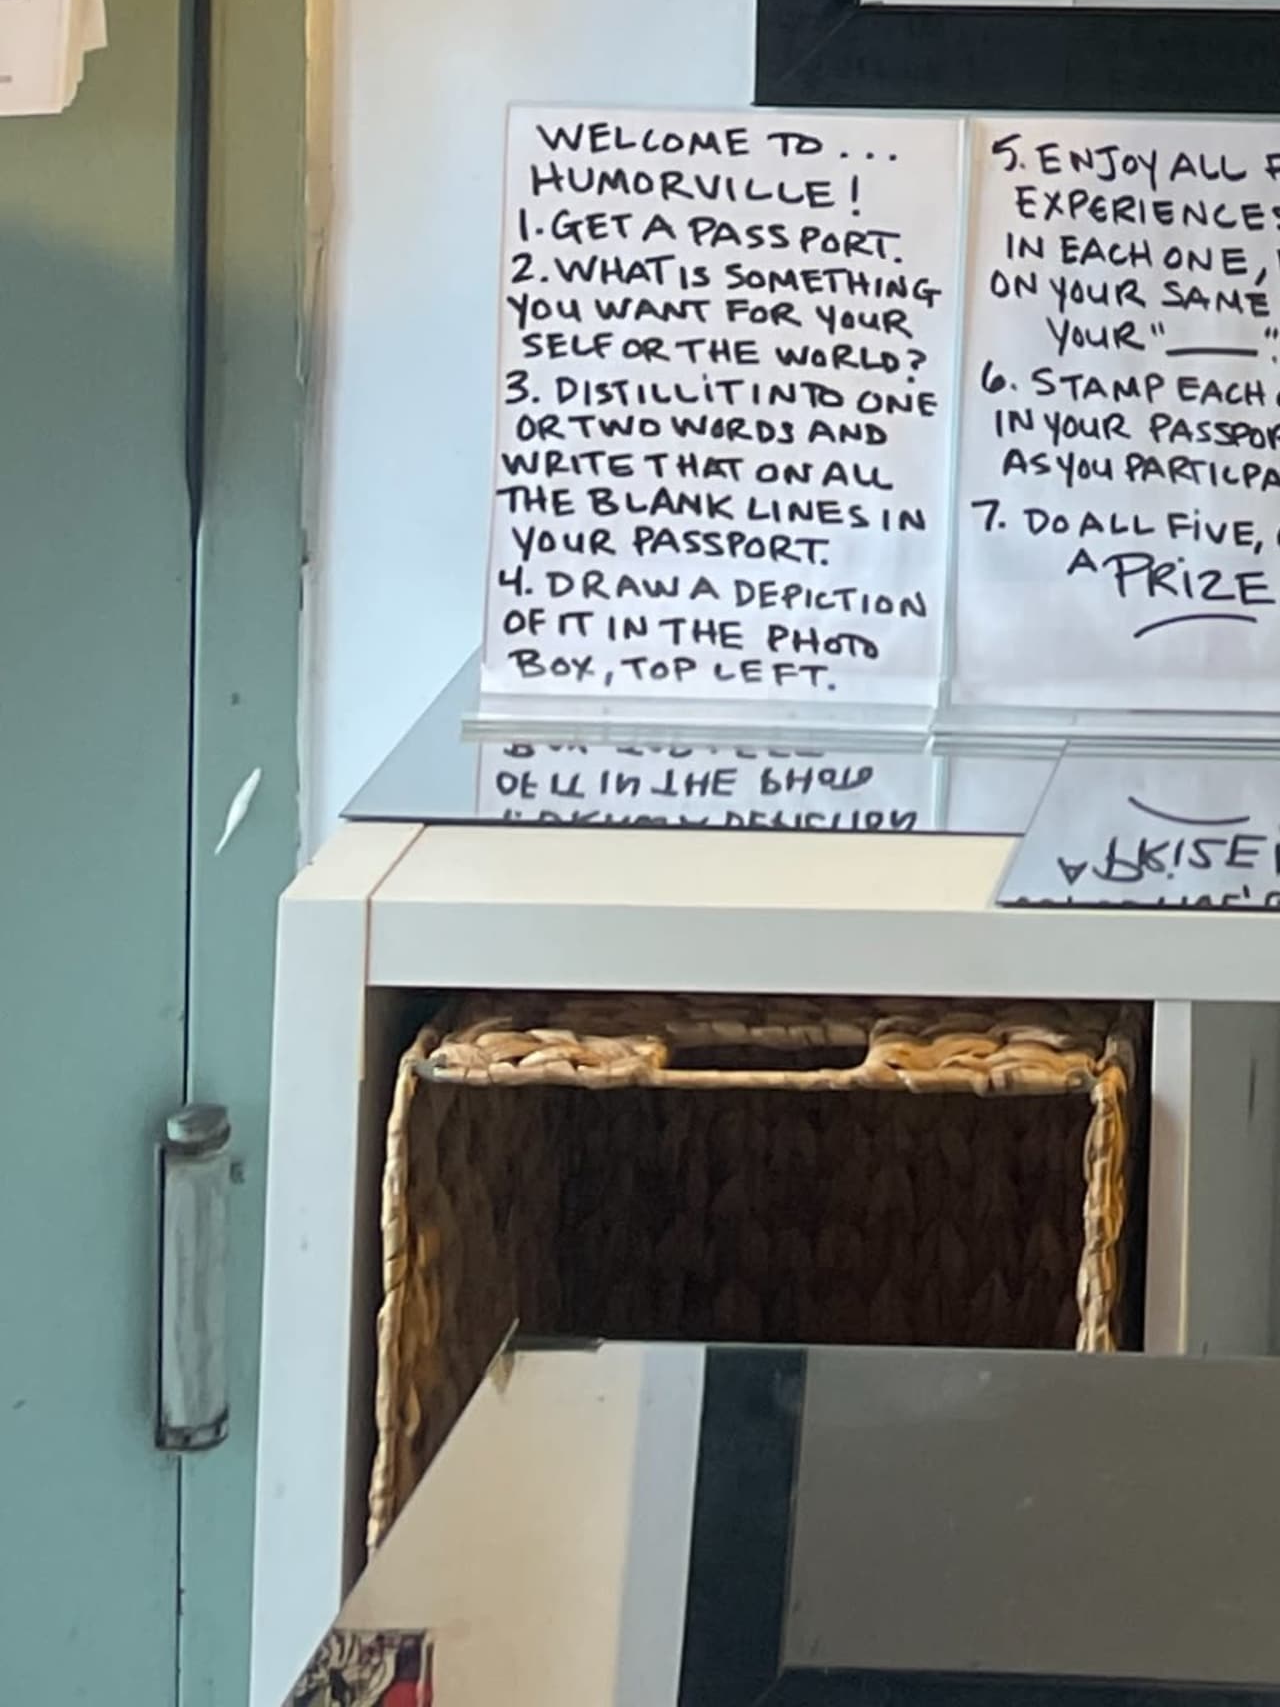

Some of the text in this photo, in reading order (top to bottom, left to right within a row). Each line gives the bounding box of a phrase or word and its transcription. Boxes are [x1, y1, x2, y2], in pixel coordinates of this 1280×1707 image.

[535, 122, 750, 157] WELCOME
[1034, 142, 1157, 192] ENJOY
[1169, 152, 1247, 182] ALL
[551, 208, 633, 245] GET
[641, 213, 677, 242] A
[687, 216, 903, 264] PASSPORT.
[553, 253, 676, 286] WHAT
[724, 262, 942, 309] SOMETHING
[1007, 232, 1045, 260] IN
[1059, 234, 1153, 268] EACH
[1162, 245, 1267, 287] ONE,
[506, 292, 913, 340] YOU WANT FOR YOUR
[990, 269, 1038, 299] ON
[1049, 275, 1147, 315] YOUR
[1161, 280, 1271, 318] SAME
[1046, 317, 1146, 357] YOUR
[621, 336, 671, 363] OR
[674, 338, 761, 365] THE
[774, 343, 927, 384] WORLD?
[555, 376, 700, 407] DISTILL
[752, 381, 845, 409] INTO
[856, 390, 938, 418] ONE
[1031, 366, 1165, 404] STAMP
[1176, 376, 1266, 407] EACH
[516, 413, 888, 446] OR TWO WORDS AND
[995, 408, 1035, 438] IN
[1043, 410, 1132, 447] YOUR
[501, 449, 894, 491] WRITE THAT ON ALL
[1002, 447, 1052, 476] AS
[1055, 451, 1114, 489] YOU
[495, 484, 926, 532] THE BLANK LINES IN
[511, 525, 830, 566] YOUR PASSPORT.
[1023, 507, 1070, 536] DO
[1078, 511, 1156, 538] ALL
[1167, 508, 1263, 556] FIVE,
[1066, 547, 1098, 576] A
[545, 569, 680, 600] DRAW
[689, 576, 720, 600] A
[734, 579, 927, 618] DEPICTION
[503, 607, 546, 636] OF
[608, 615, 648, 642] IN
[658, 617, 743, 650] THE
[767, 624, 879, 660] PHOTO
[507, 648, 836, 691] BOX, TOP LEFT.
